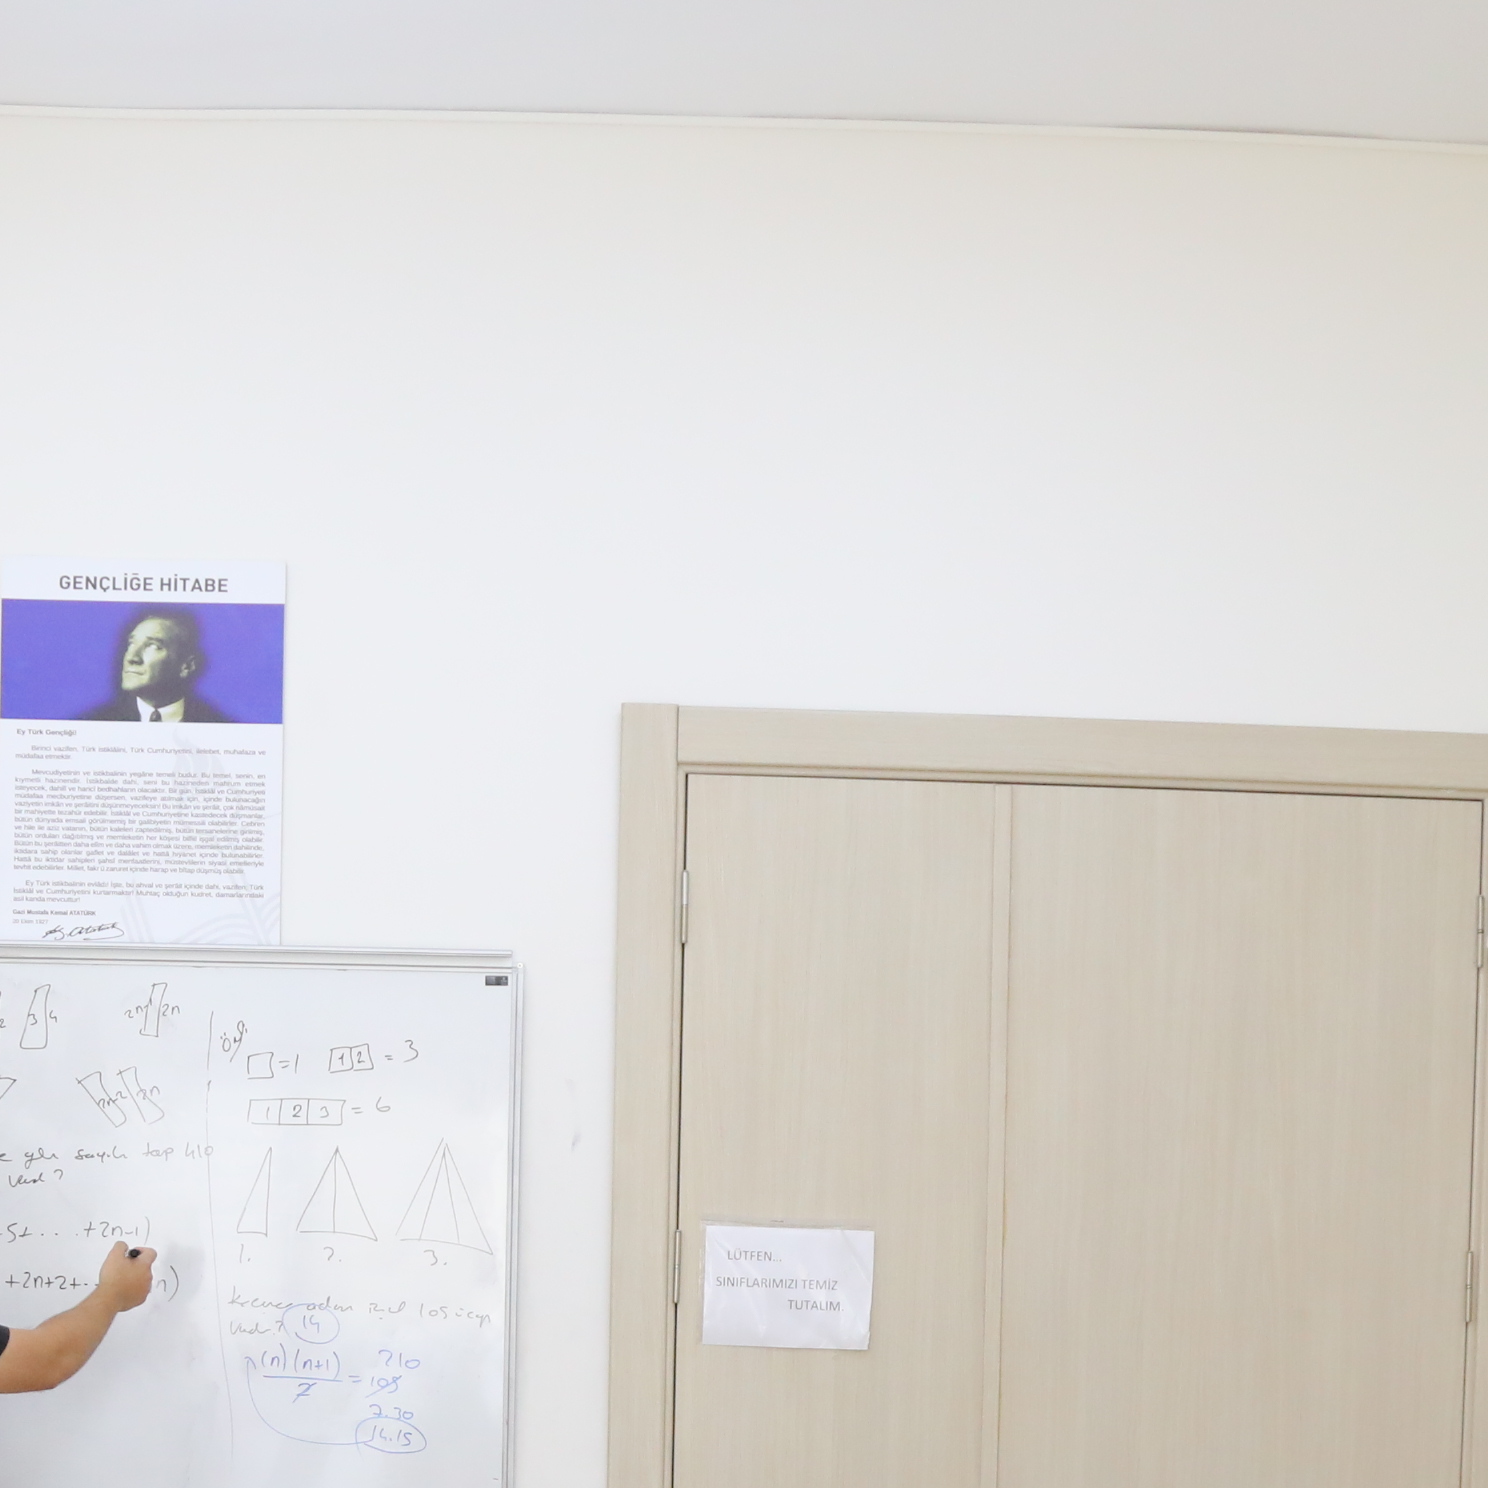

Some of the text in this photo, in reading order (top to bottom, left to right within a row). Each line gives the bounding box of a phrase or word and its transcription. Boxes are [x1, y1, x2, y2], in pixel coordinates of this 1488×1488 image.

[59, 572, 229, 593] GENÇLİĞE HİTABE
[715, 1276, 838, 1291] SINIFLARIMIZI TEMİZ
[787, 1299, 845, 1312] TUTALIM.
